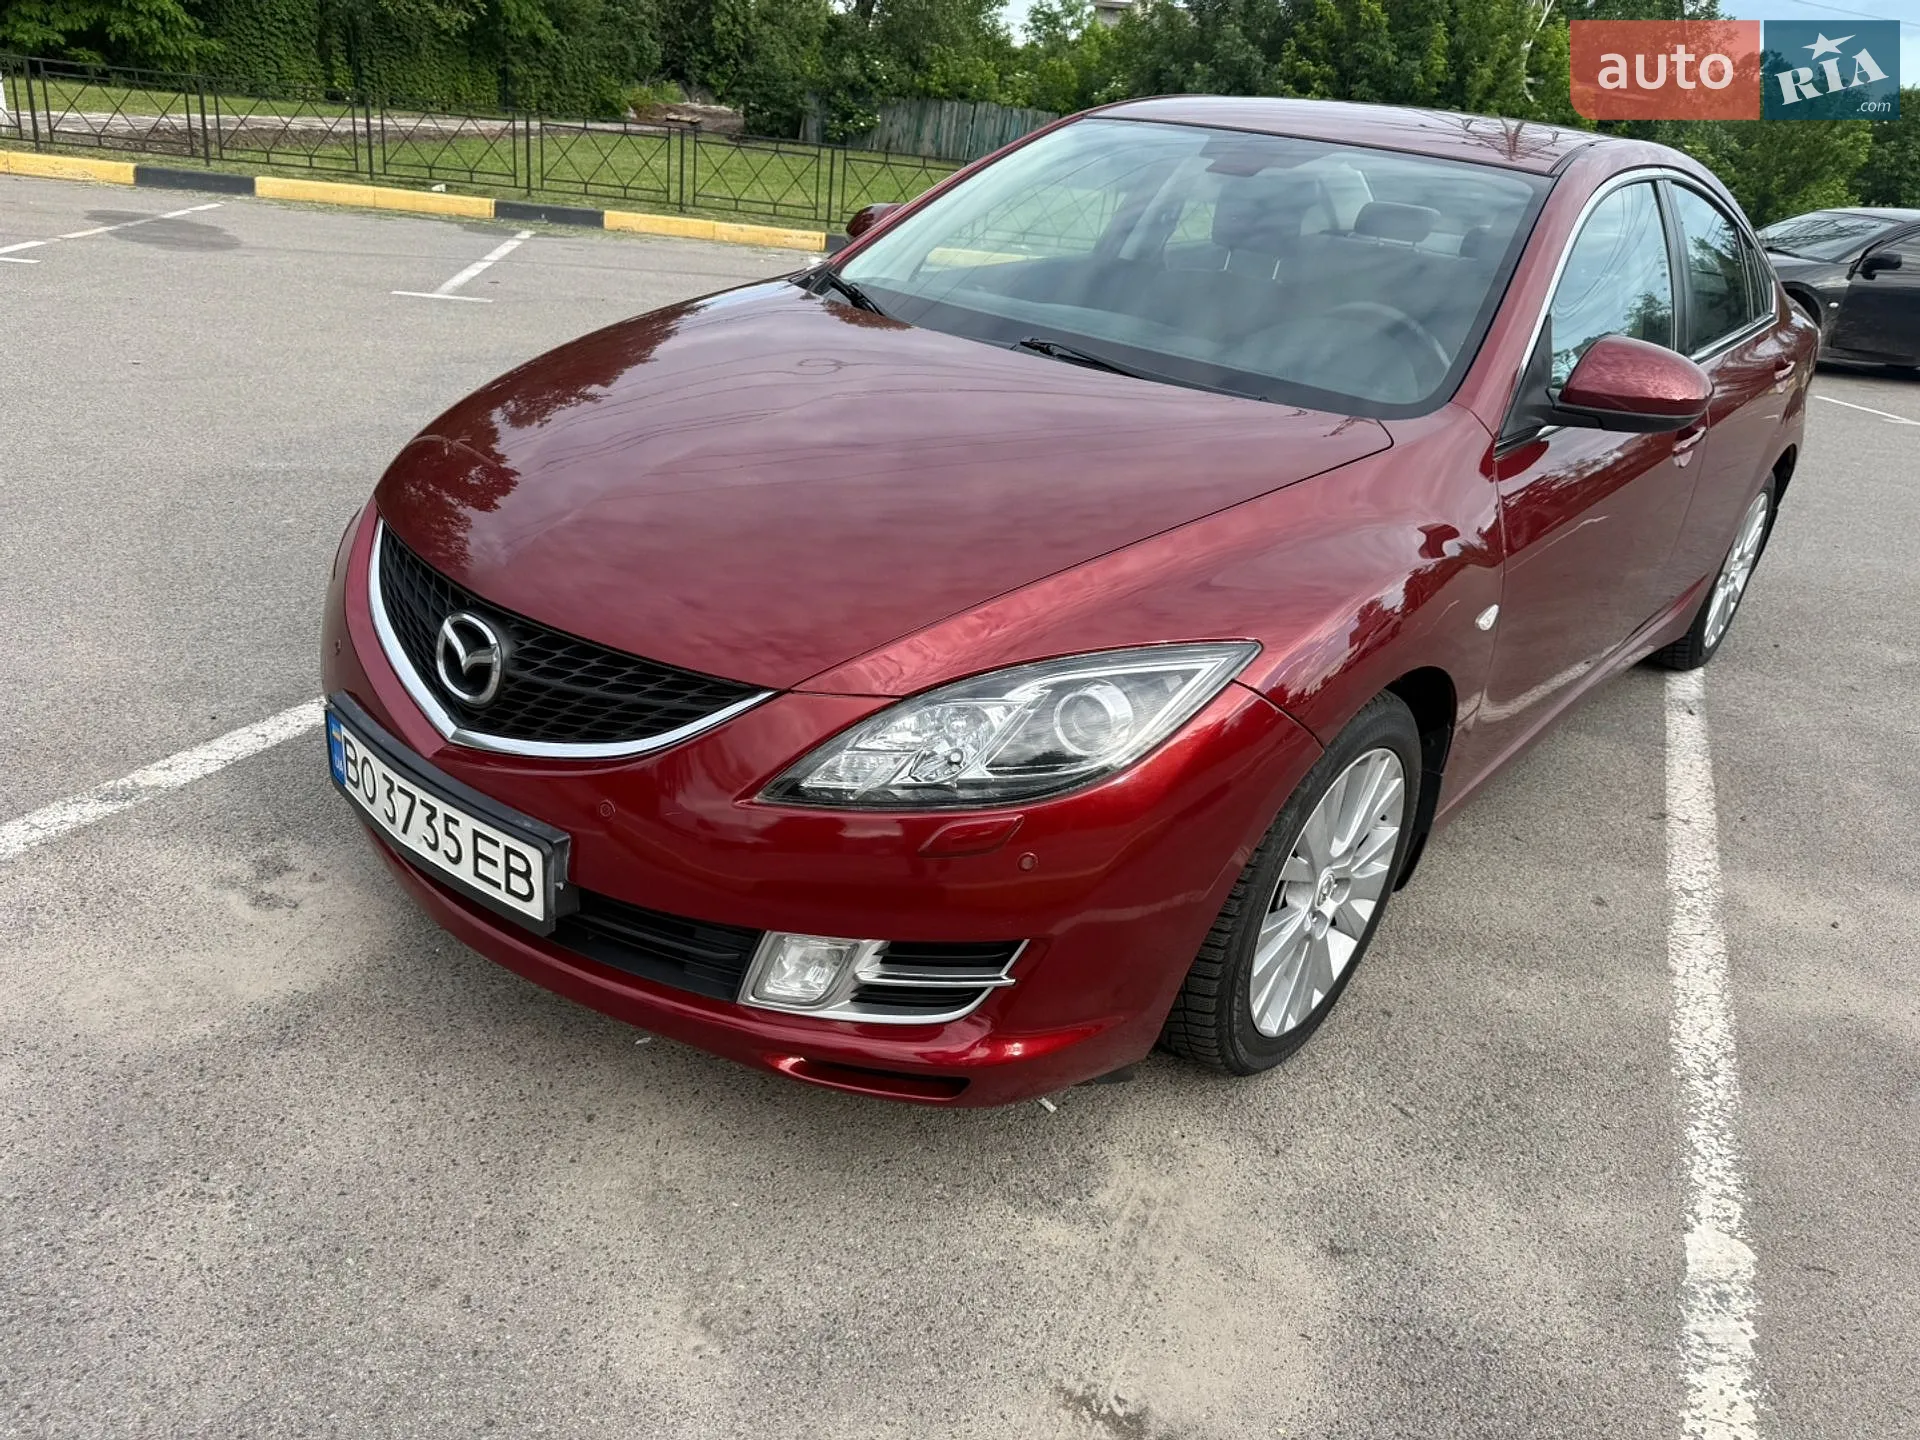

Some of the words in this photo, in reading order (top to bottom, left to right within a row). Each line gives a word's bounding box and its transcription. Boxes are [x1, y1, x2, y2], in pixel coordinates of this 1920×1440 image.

[343, 735, 377, 804] BO
[383, 772, 462, 865] 3735
[472, 828, 535, 902] EB
